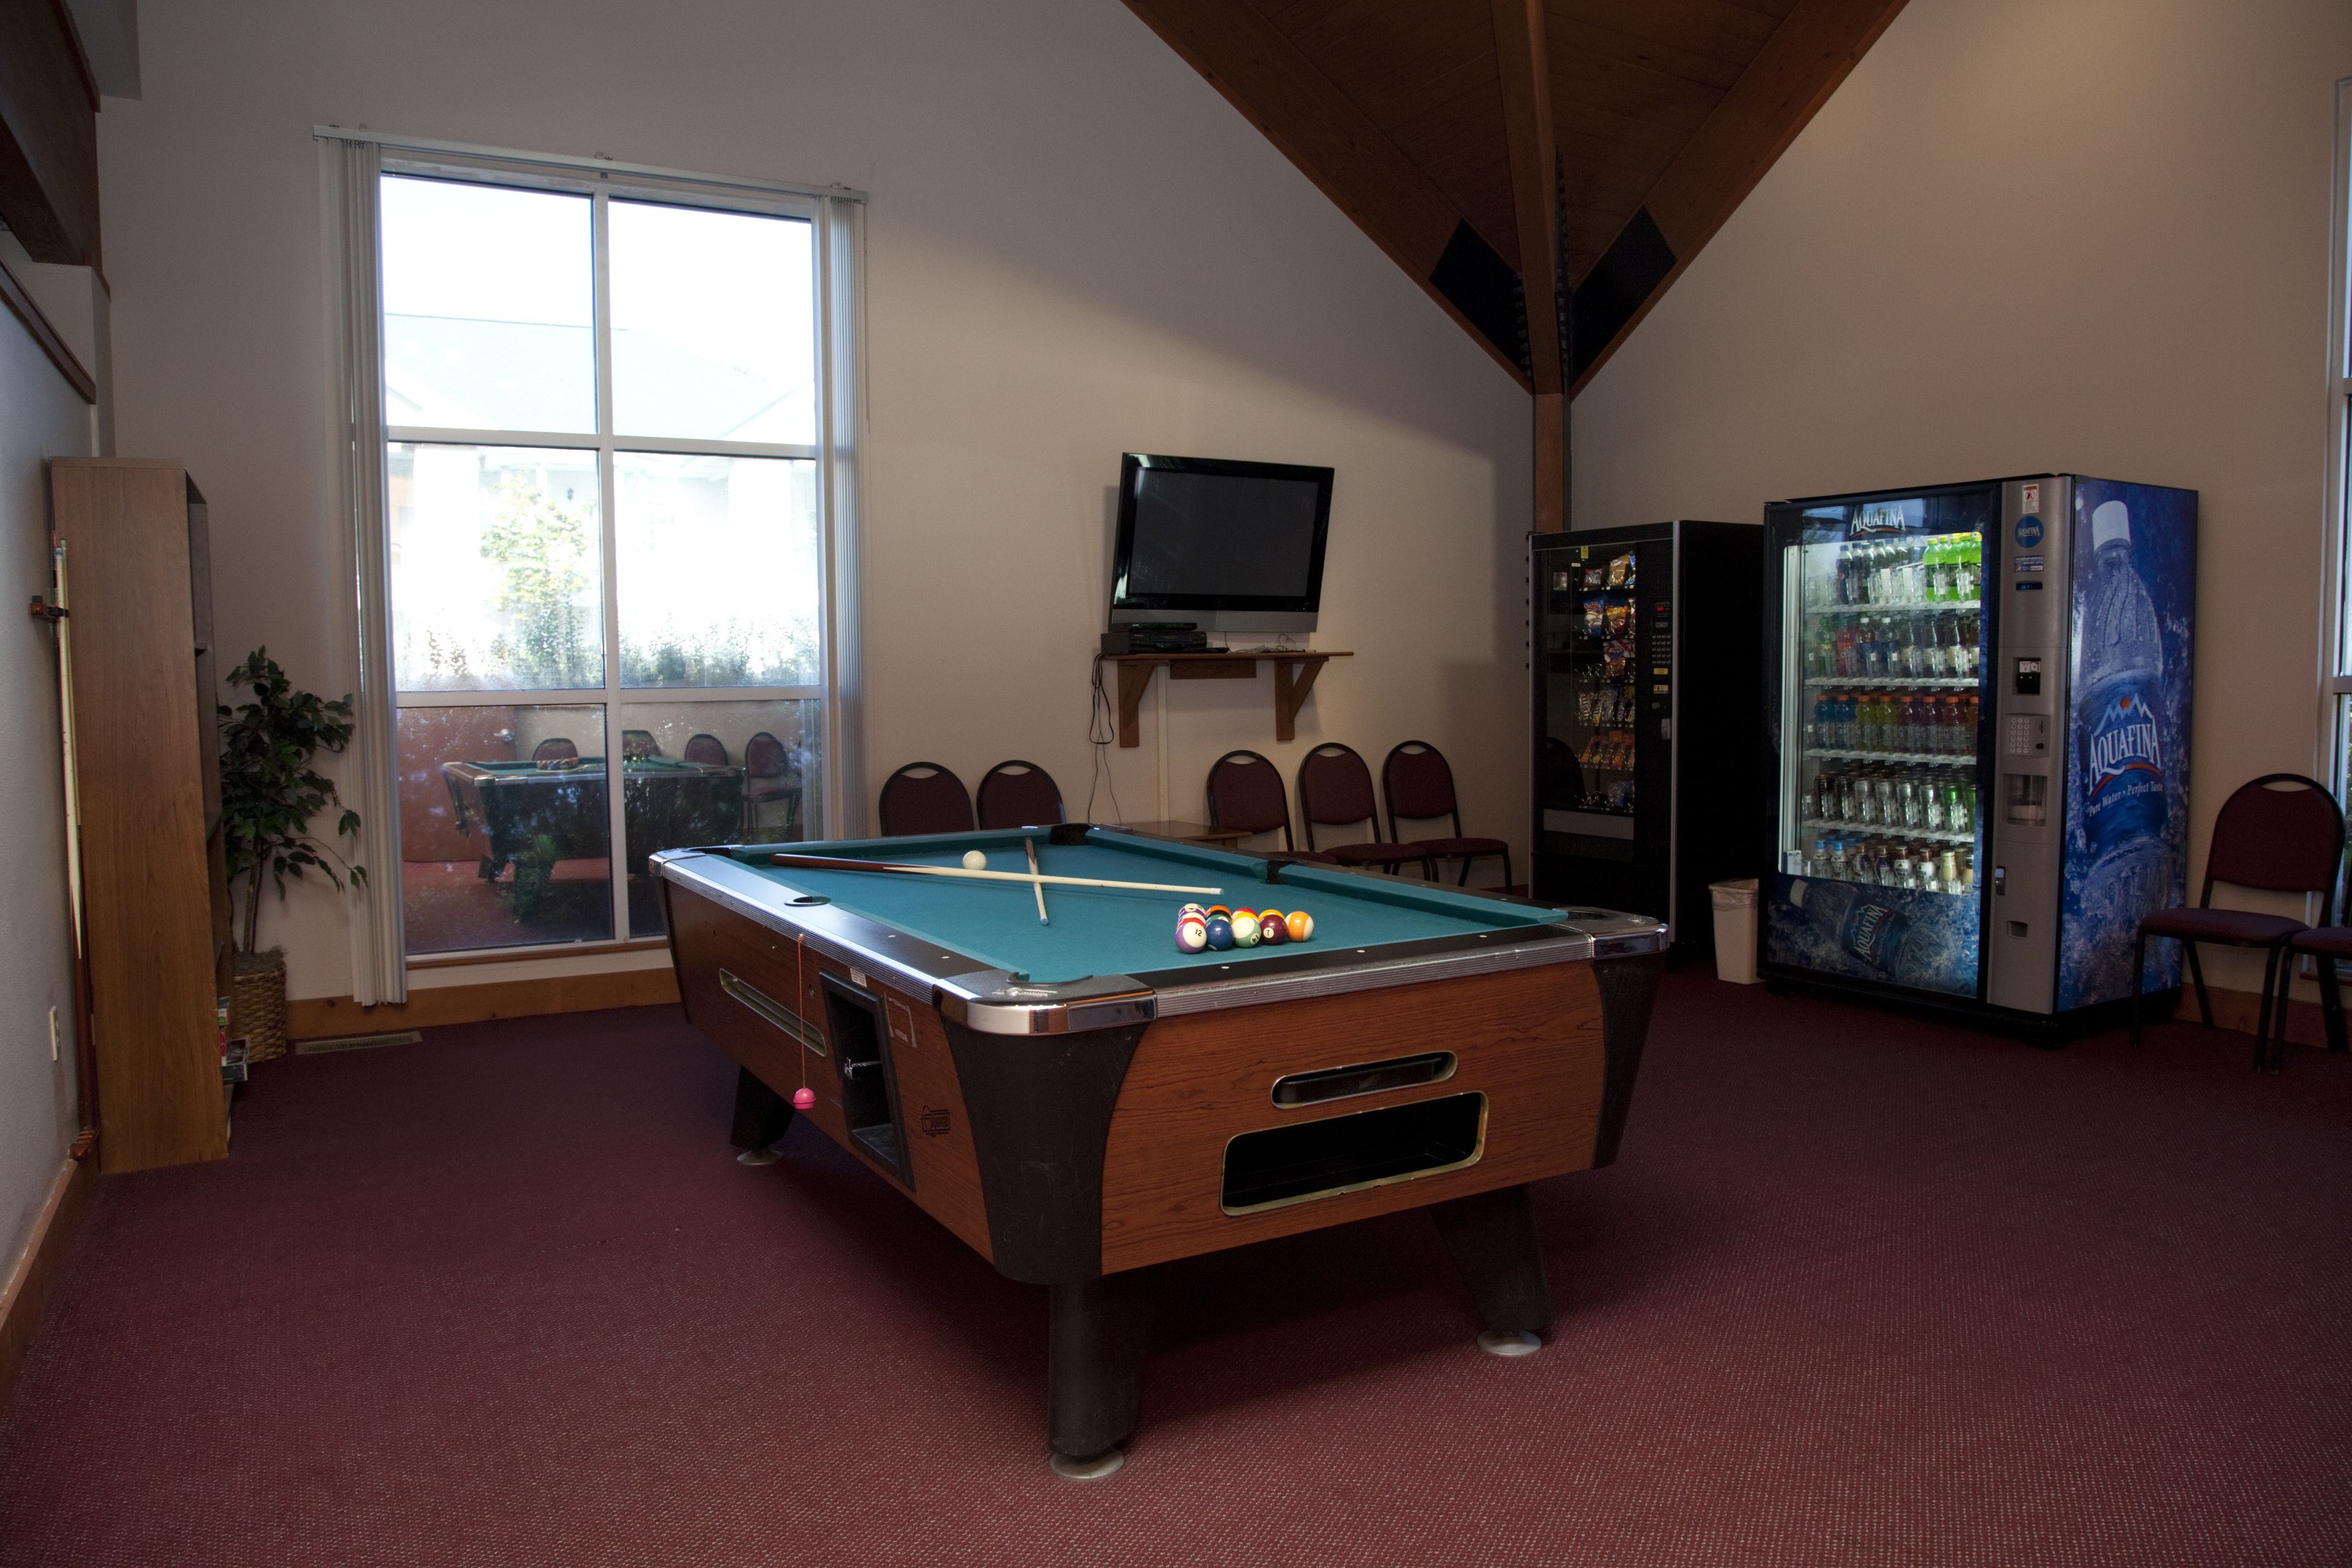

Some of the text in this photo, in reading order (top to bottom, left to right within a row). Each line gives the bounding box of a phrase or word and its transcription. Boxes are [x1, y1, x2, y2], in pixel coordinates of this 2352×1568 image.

[1849, 505, 1907, 537] AQUAFINA
[2017, 525, 2040, 538] AQUAFINA
[2088, 715, 2162, 796] AQUAFINA
[2089, 781, 2163, 817] Pure Water Perfect Taste
[1252, 934, 1259, 943] 14
[1853, 903, 1888, 961] AQUAFINA
